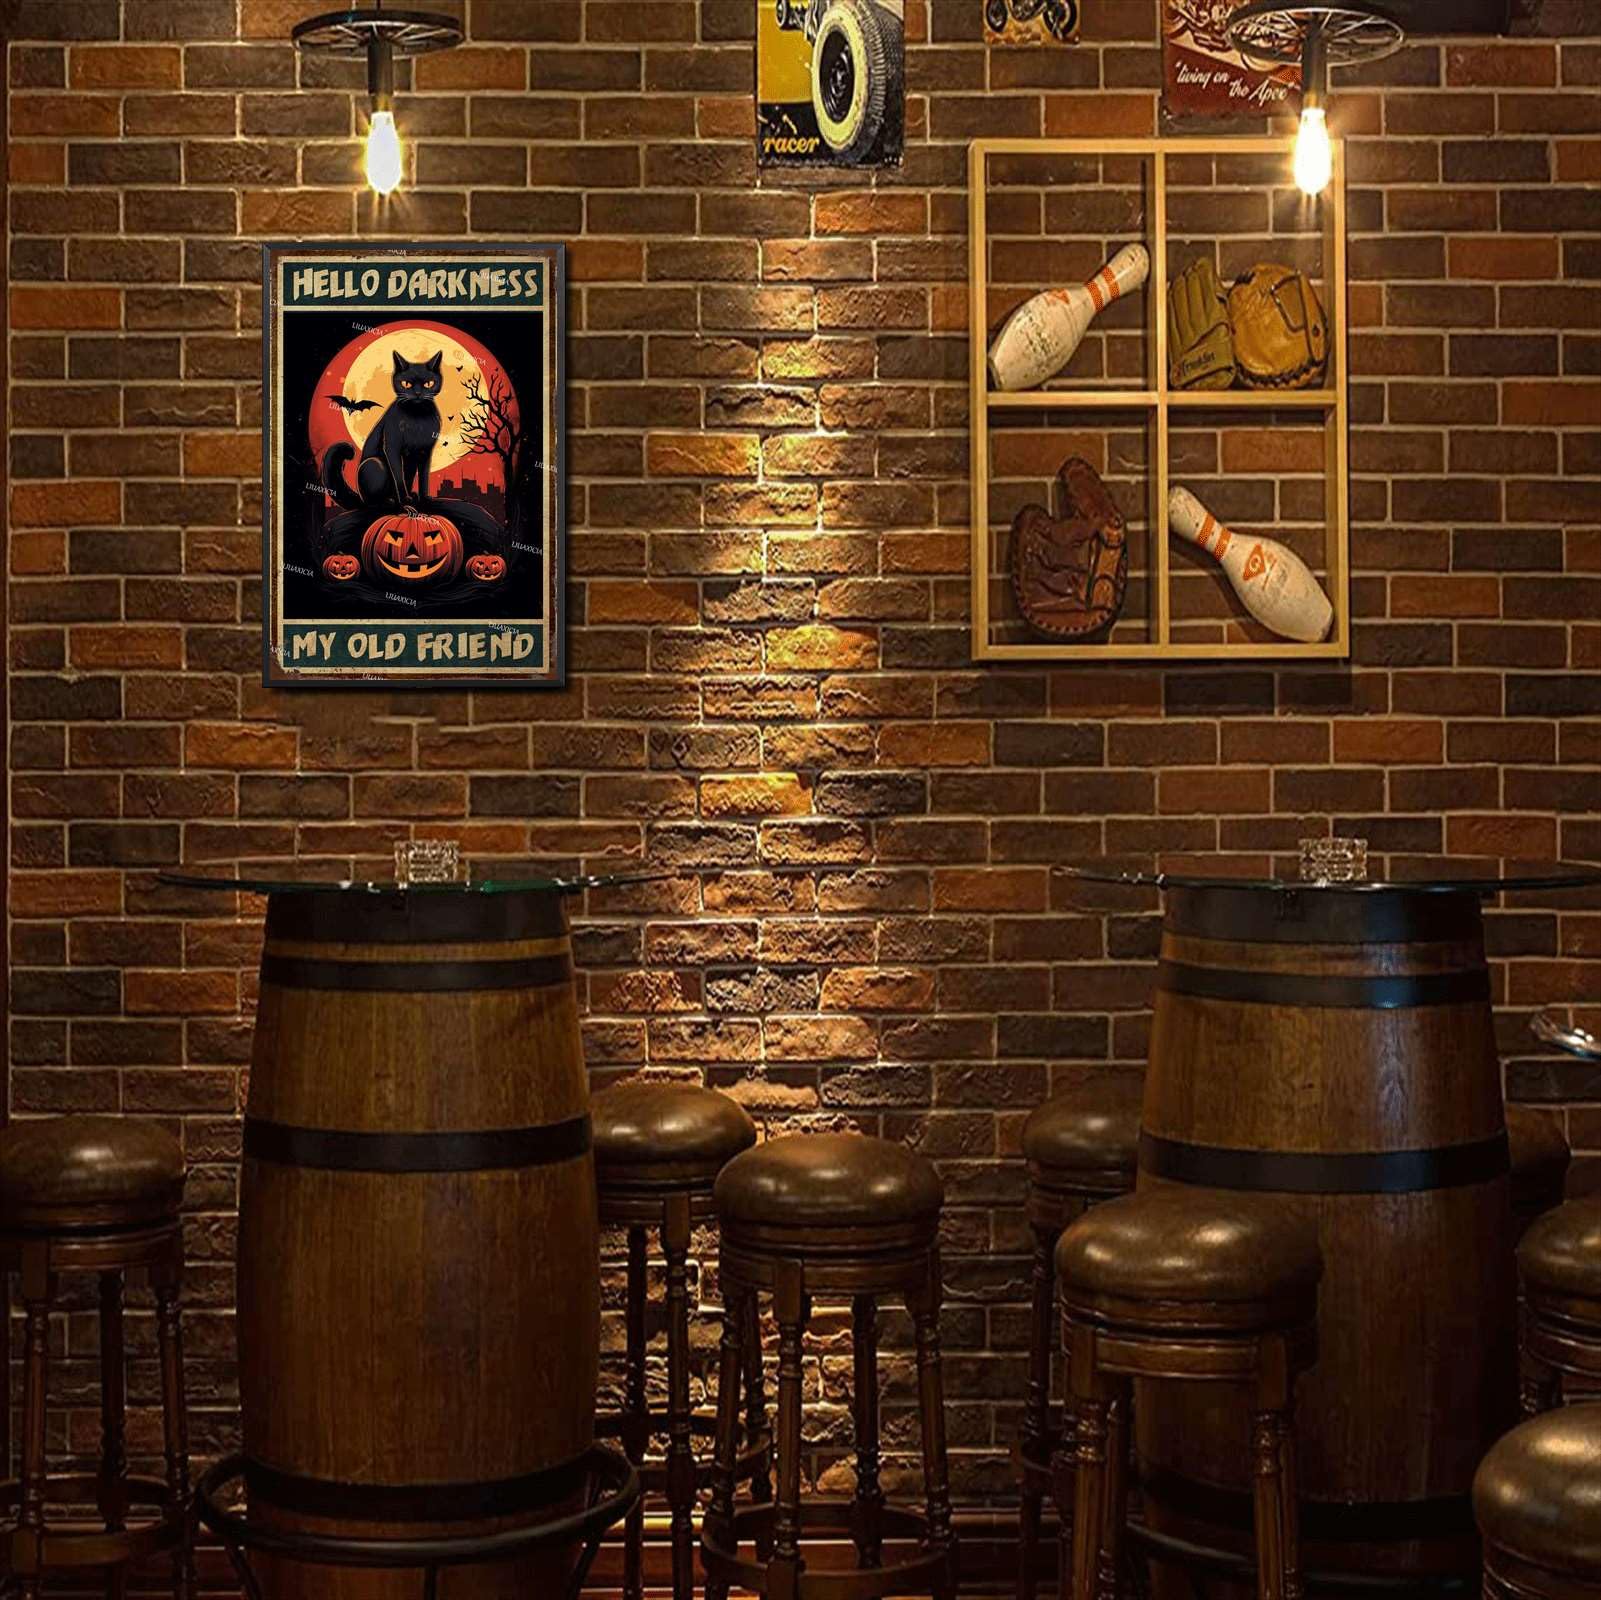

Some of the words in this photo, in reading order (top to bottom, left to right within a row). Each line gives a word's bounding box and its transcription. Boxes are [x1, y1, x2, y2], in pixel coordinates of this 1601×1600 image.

[762, 136, 820, 154] racer
[293, 267, 380, 301] HELLO
[387, 267, 538, 301] DARKNESS
[292, 630, 337, 661] MY
[347, 632, 407, 661] OLD
[416, 631, 534, 662] FRIEND
